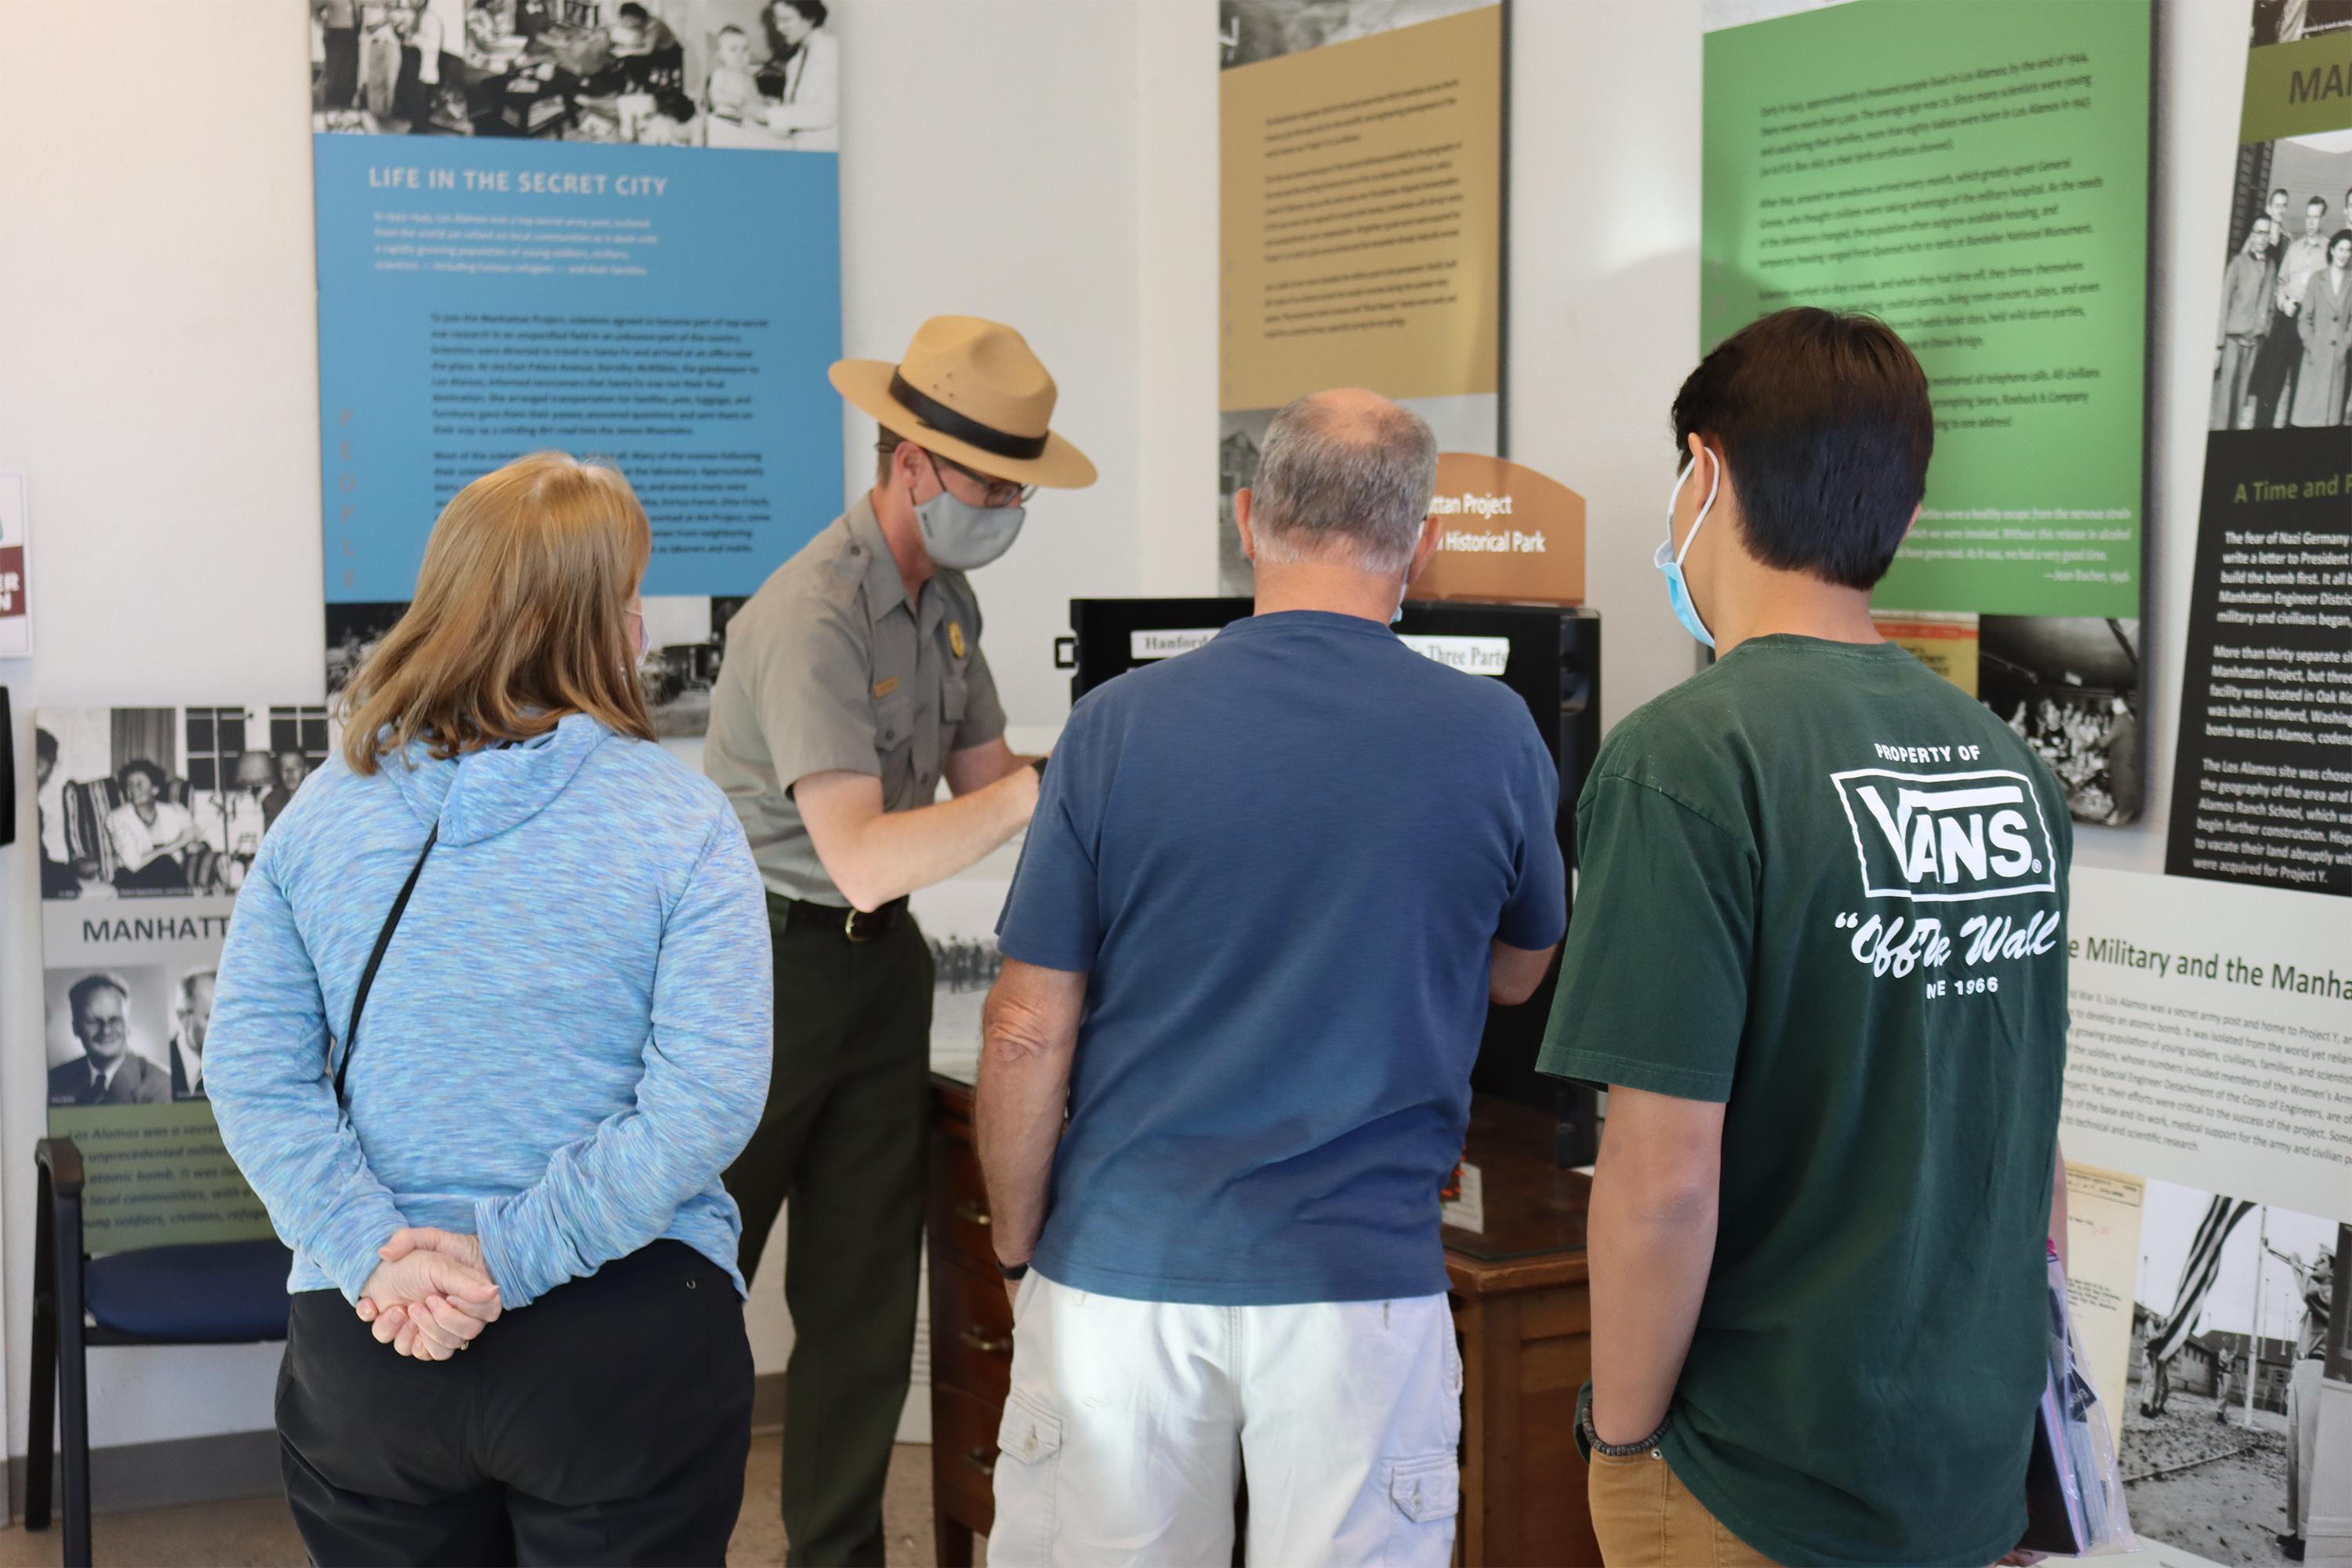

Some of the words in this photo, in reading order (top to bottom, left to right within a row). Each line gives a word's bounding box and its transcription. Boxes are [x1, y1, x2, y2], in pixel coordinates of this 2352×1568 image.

[2288, 64, 2352, 104] MA
[368, 165, 420, 189] LIFE
[429, 169, 456, 190] IN
[463, 170, 510, 192] THE
[517, 172, 608, 195] SECRET
[615, 175, 668, 196] CITY
[2234, 483, 2248, 504] A
[2252, 480, 2298, 503] Time
[2303, 474, 2339, 498] and
[1429, 495, 1461, 514] ttan
[1463, 492, 1512, 520] Project
[1445, 529, 1510, 553] Historical
[1512, 529, 1546, 553] Park
[2225, 530, 2244, 545] The
[2245, 529, 2266, 544] fear
[2266, 530, 2278, 545] of
[2278, 530, 2302, 545] Nazi
[2302, 531, 2350, 547] Germany
[2223, 551, 2249, 564] write
[2249, 553, 2257, 564] a
[2258, 550, 2286, 564] letter
[2287, 551, 2299, 564] to
[2300, 550, 2349, 565] President
[2220, 569, 2247, 583] build
[2247, 570, 2264, 584] the
[2265, 570, 2296, 585] bomb
[2332, 571, 2347, 585] all
[2219, 590, 2273, 604] Manhattan
[2274, 590, 2318, 608] Engineer
[2216, 609, 2256, 626] military
[2256, 610, 2276, 624] and
[2276, 611, 2317, 626] civilians
[1428, 644, 1466, 666] Three
[2213, 644, 2241, 659] More
[2241, 645, 2265, 659] than
[2266, 646, 2295, 664] thirty
[2296, 650, 2340, 664] separate
[2211, 664, 2265, 680] Manhattan
[2266, 667, 2306, 684] Project,
[2307, 668, 2325, 683] but
[2209, 683, 2242, 701] facility
[2243, 688, 2263, 699] was
[2265, 686, 2303, 702] located
[2303, 688, 2314, 702] in
[2315, 689, 2337, 704] Oak
[2207, 706, 2227, 717] was
[2228, 704, 2252, 719] built
[2252, 706, 2263, 719] in
[2264, 707, 2309, 724] Hanford,
[2205, 722, 2234, 738] bomb
[2235, 728, 2256, 739] was
[2257, 726, 2274, 740] Los
[2274, 727, 2316, 745] Alamos,
[1875, 742, 1951, 764] PROPERTY
[1958, 744, 1980, 761] OF
[2202, 757, 2221, 772] The
[2222, 760, 2239, 774] Los
[2240, 760, 2277, 777] Alamos
[2278, 764, 2297, 779] site
[2298, 768, 2319, 780] was
[2200, 778, 2217, 792] the
[2218, 782, 2270, 799] geography
[2270, 783, 2283, 797] of
[2284, 785, 2302, 799] the
[2303, 789, 2327, 801] area
[2327, 789, 2349, 803] and
[2198, 797, 2234, 813] Alamos
[2235, 800, 2267, 816] Ranch
[2267, 803, 2304, 821] School,
[2305, 807, 2338, 822] which
[2196, 816, 2224, 833] begin
[2225, 819, 2261, 835] further
[2260, 826, 2327, 842] construction.
[2194, 837, 2207, 850] to
[2207, 840, 2240, 853] vacate
[2240, 841, 2265, 855] their
[2266, 844, 2289, 858] land
[2289, 847, 2334, 866] abruptly
[2193, 858, 2218, 871] were
[2218, 862, 2263, 876] acquired
[2263, 864, 2279, 877] for
[2279, 866, 2317, 883] Project
[2318, 869, 2328, 884] Y.
[82, 916, 229, 942] MANHATT
[1959, 910, 2060, 966] Wall
[2086, 937, 2170, 978] Military
[2176, 953, 2219, 980] and
[2226, 956, 2263, 986] the
[2270, 963, 2352, 1001] Manha
[1954, 976, 1998, 995] 1966
[2200, 1012, 2220, 1025] army
[2223, 1016, 2241, 1027] post
[2243, 1020, 2259, 1030] and
[2261, 1020, 2285, 1034] home
[2287, 1025, 2297, 1036] to
[2299, 1027, 2331, 1042] Project
[2245, 1037, 2266, 1050] from
[2267, 1041, 2283, 1054] the
[2284, 1047, 2310, 1058] world
[2311, 1051, 2325, 1062] yet
[2259, 1058, 2295, 1075] families,
[2297, 1067, 2314, 1078] and
[2262, 1080, 2273, 1090] of
[2273, 1080, 2288, 1093] the
[2290, 1084, 2332, 1102] Women's
[2241, 1094, 2267, 1109] Corps
[2268, 1100, 2278, 1110] of
[2279, 1102, 2324, 1120] Engineers,
[2326, 1112, 2341, 1123] are
[2265, 1120, 2276, 1129] of
[2276, 1120, 2292, 1132] the
[2293, 1125, 2326, 1139] project.
[2238, 1131, 2251, 1142] for
[2252, 1136, 2268, 1147] the
[2269, 1142, 2291, 1154] army
[2293, 1146, 2310, 1156] and
[2311, 1149, 2343, 1163] civilian
